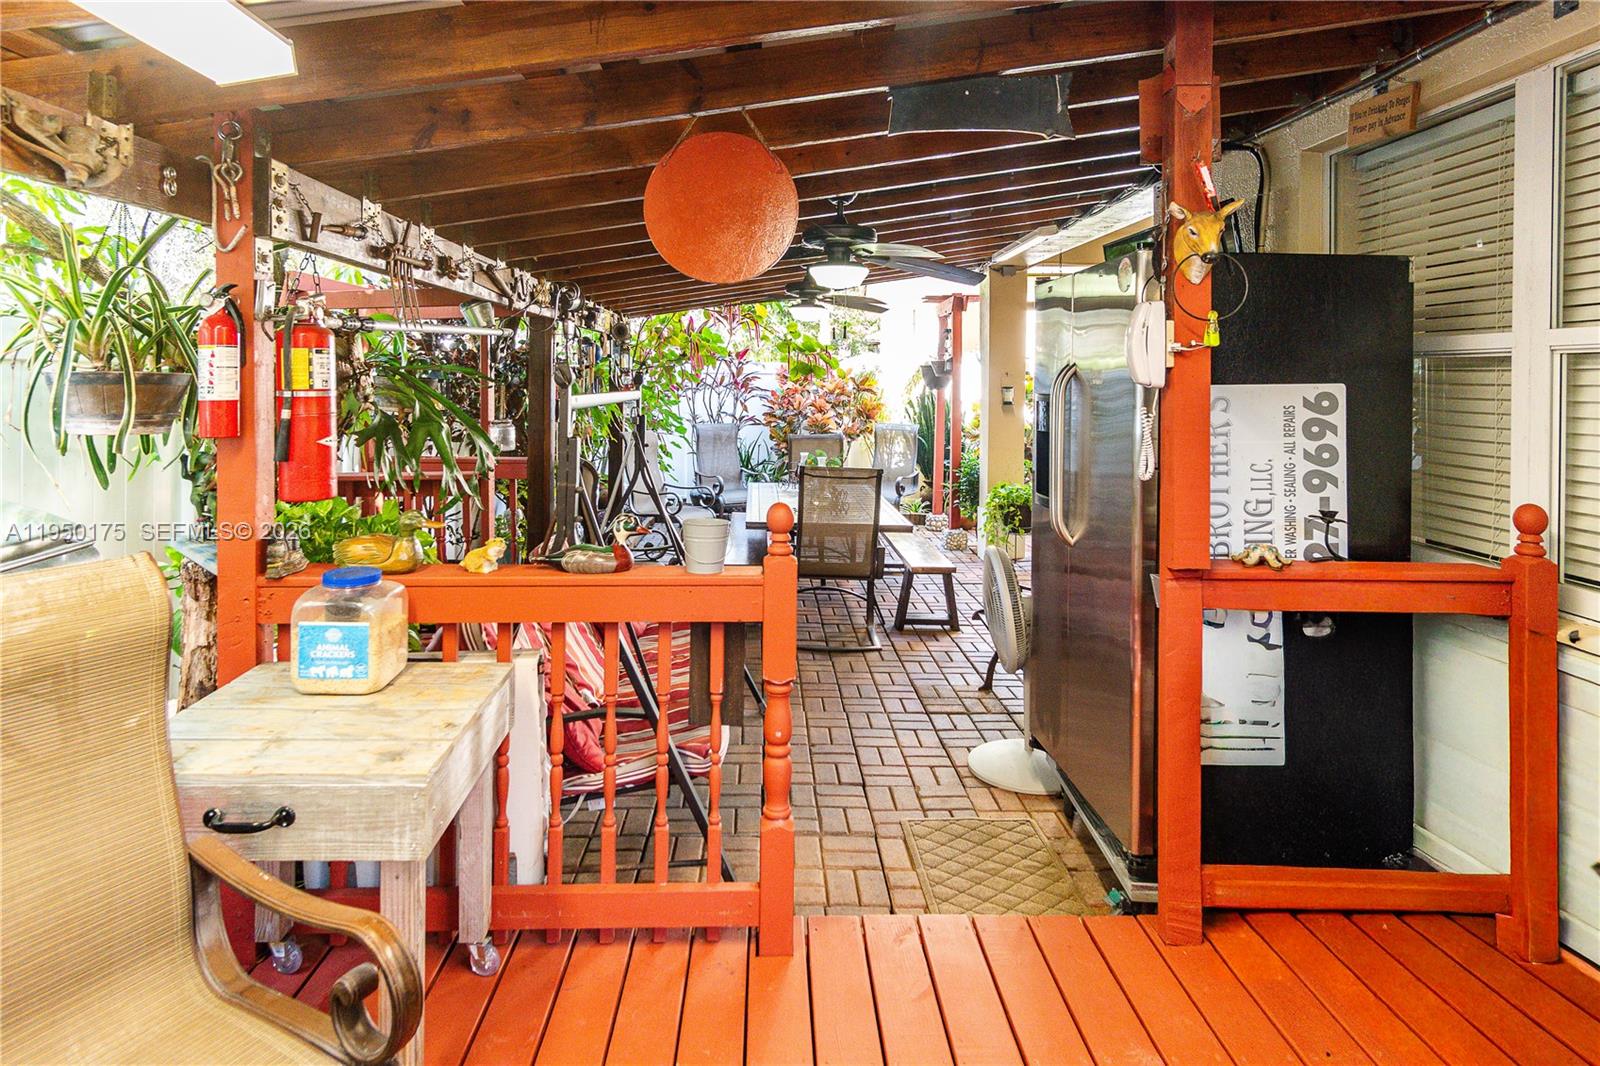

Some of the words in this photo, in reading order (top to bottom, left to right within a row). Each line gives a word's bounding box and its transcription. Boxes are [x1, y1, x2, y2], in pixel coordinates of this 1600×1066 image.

[1283, 404, 1296, 438] REPAIRS
[1283, 441, 1296, 455] ALL
[1283, 462, 1296, 498] SEALING
[1284, 504, 1297, 549] WASHING
[309, 650, 356, 659] CRACKERS
[316, 643, 349, 651] ANIMAL
